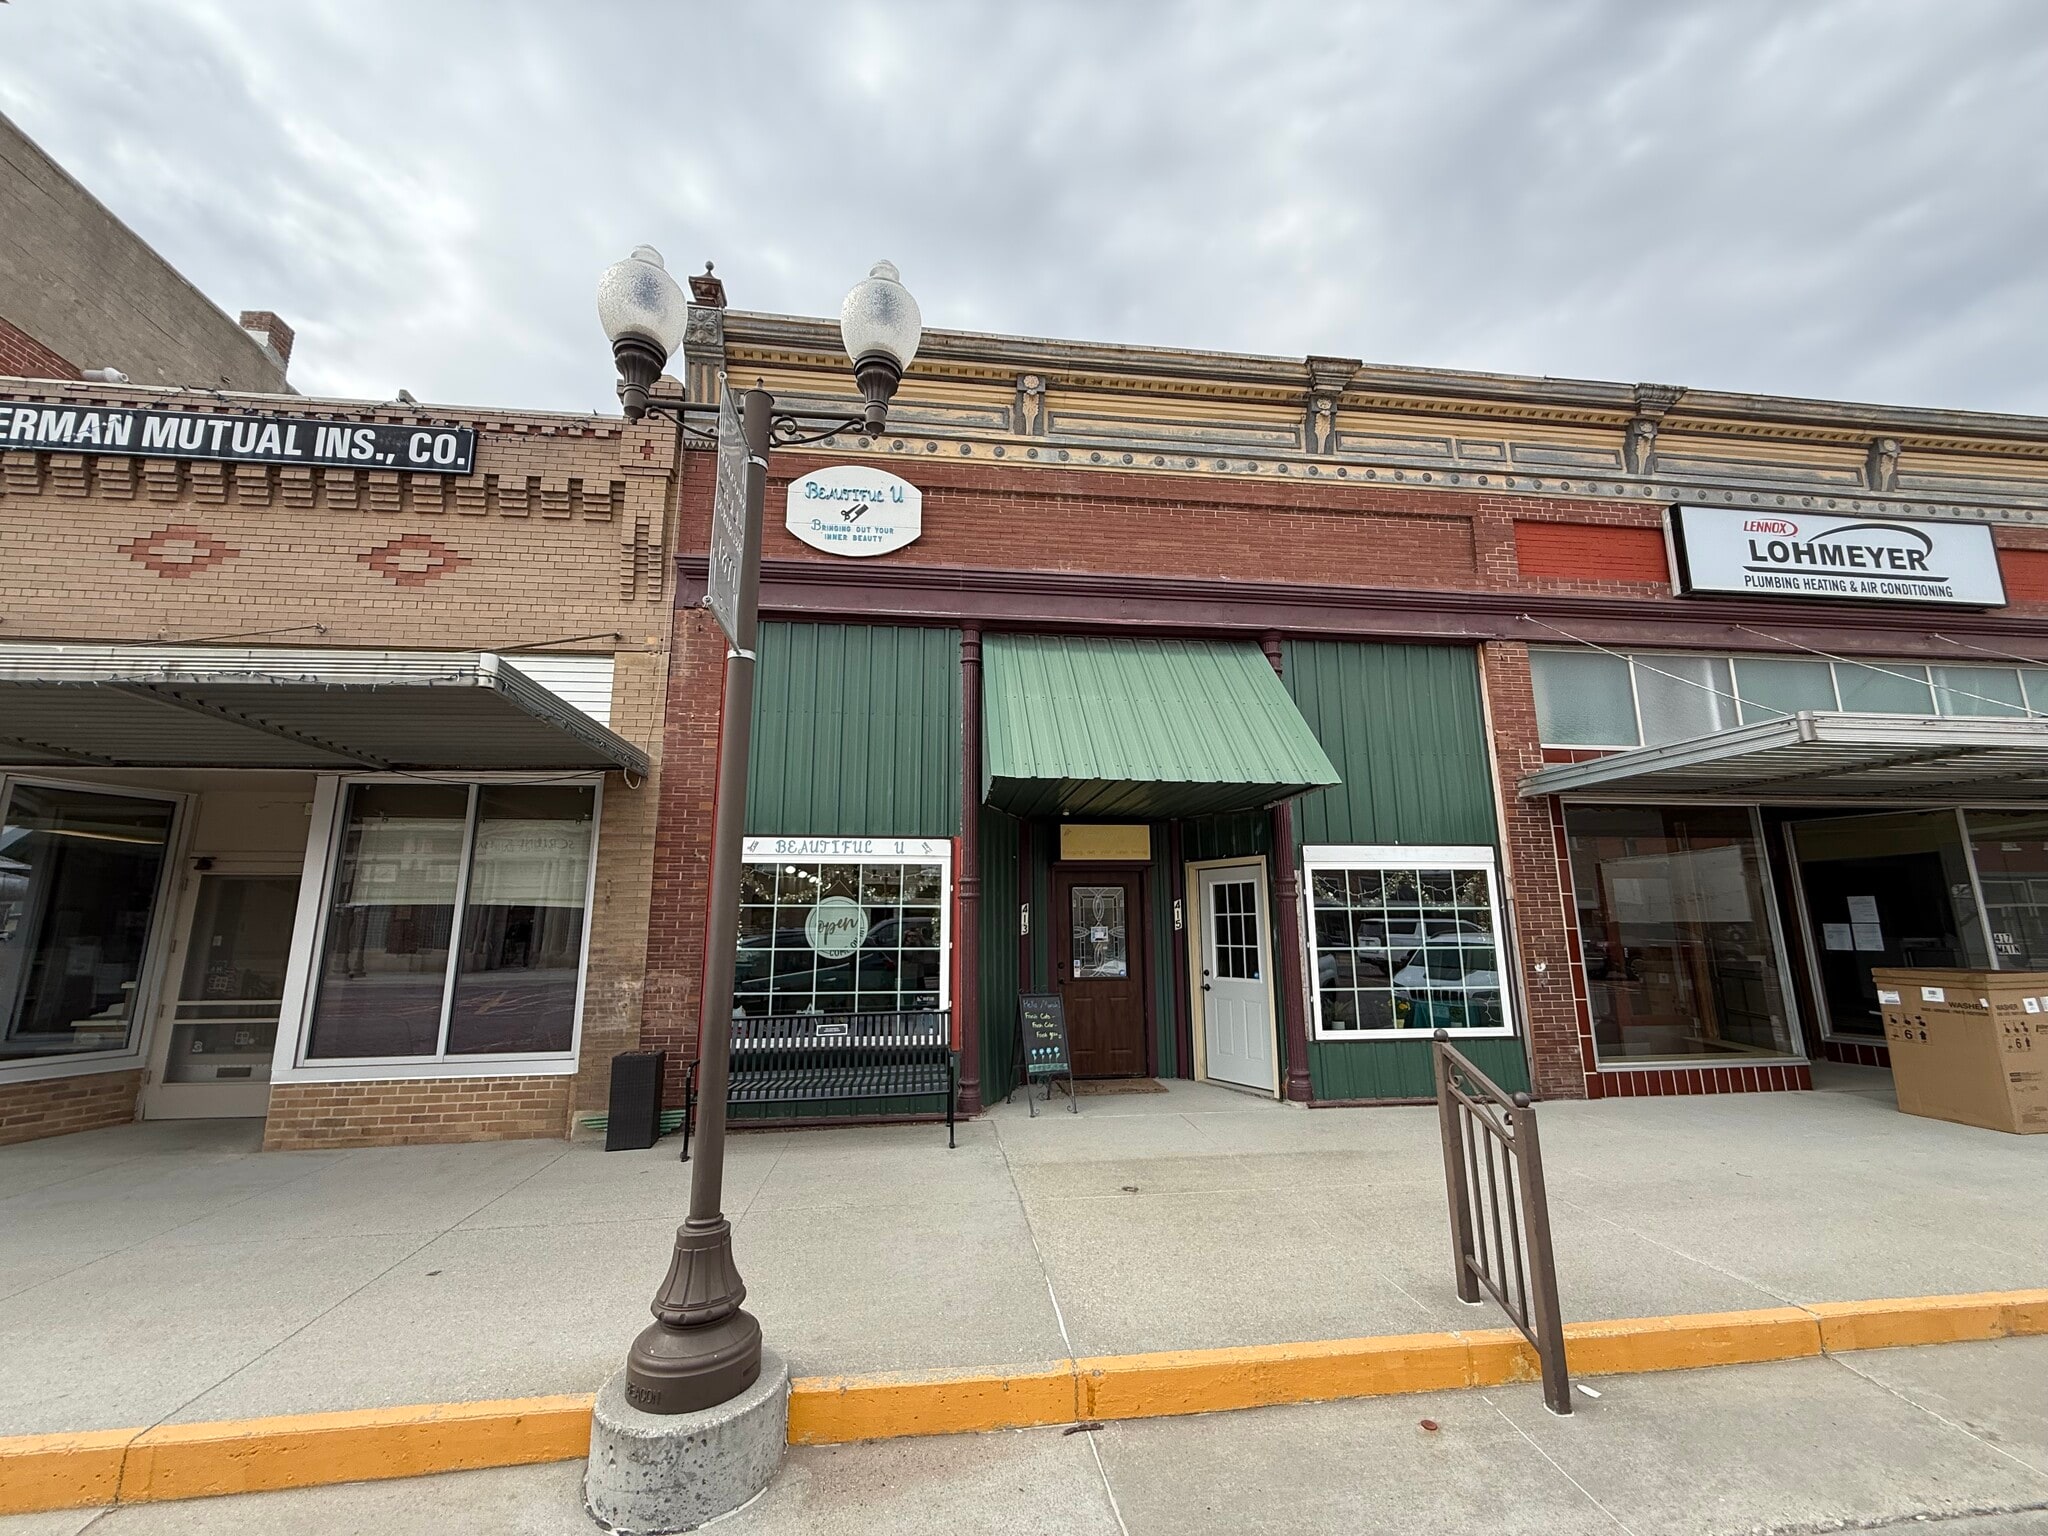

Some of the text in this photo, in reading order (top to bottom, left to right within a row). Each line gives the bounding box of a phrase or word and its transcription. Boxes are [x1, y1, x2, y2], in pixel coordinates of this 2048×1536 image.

[141, 416, 302, 456] MUTUAL
[314, 426, 395, 465] INS.,
[408, 432, 465, 465] CO.
[890, 486, 904, 503] U
[874, 526, 894, 534] YOUR
[1744, 520, 1787, 534] LENNOX
[852, 534, 883, 542] BEAUTY
[1748, 539, 1929, 571] LOHMEYER
[1744, 575, 1953, 598] PLUMBING HEATING & AIR CONDITIONING
[775, 840, 904, 854] BEAUTIFUL U
[1174, 900, 1182, 929] 415
[817, 917, 859, 945] open
[1995, 934, 2010, 942] 417
[1996, 945, 2020, 953] MAIN
[1905, 1030, 1912, 1039] 6
[2016, 1038, 2022, 1048] 6
